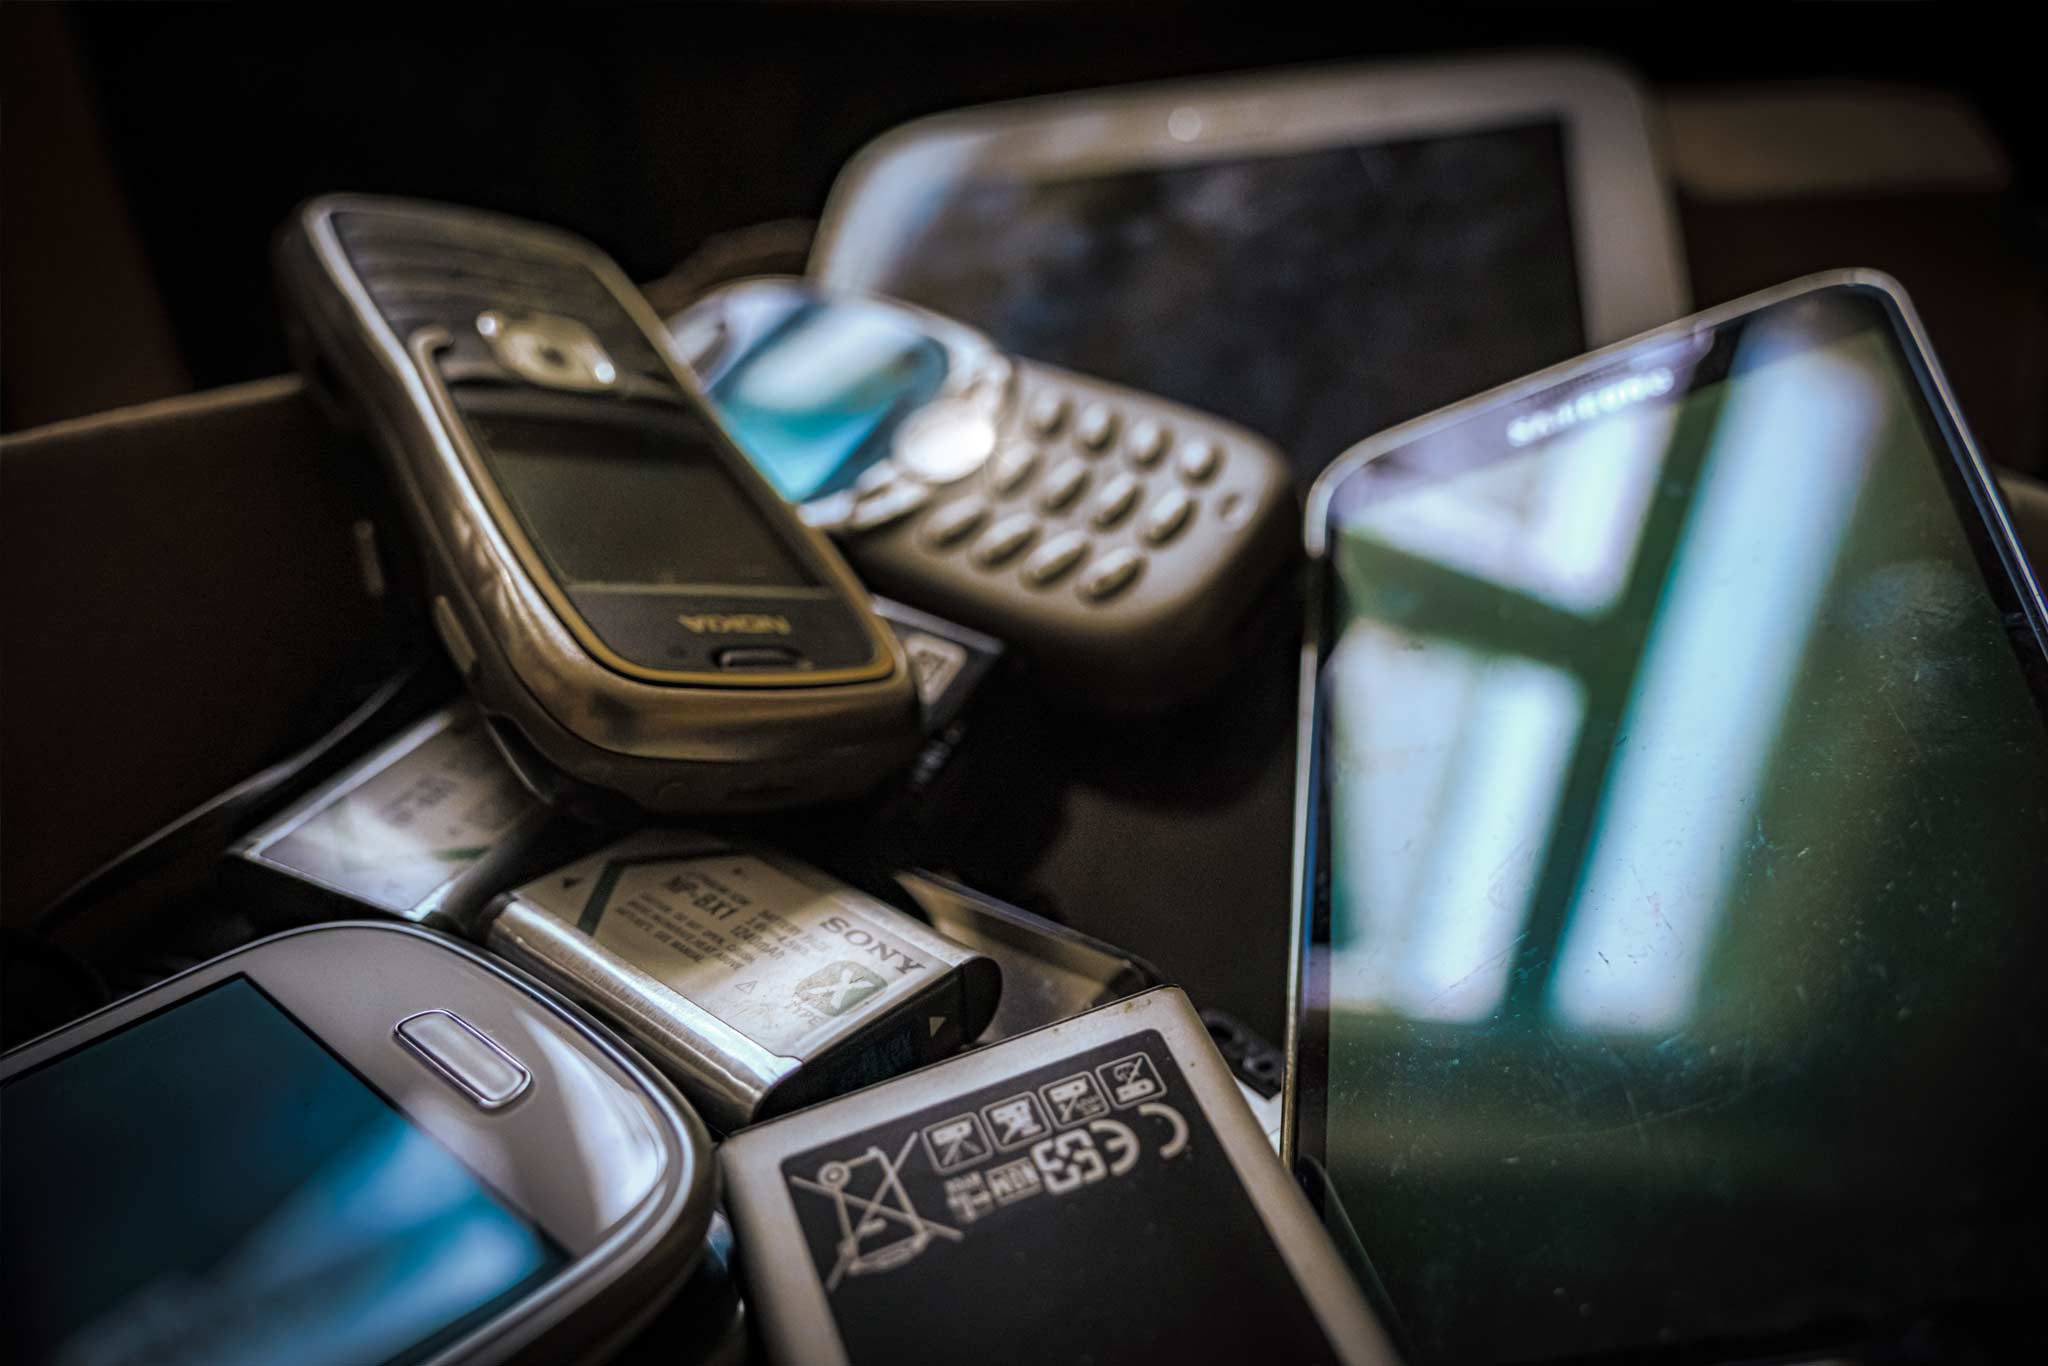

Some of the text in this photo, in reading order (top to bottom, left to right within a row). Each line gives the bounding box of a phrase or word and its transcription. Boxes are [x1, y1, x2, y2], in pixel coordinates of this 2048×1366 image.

[678, 614, 791, 635] NOKIA
[819, 916, 927, 975] SONY
[1091, 1103, 1189, 1176] CE
